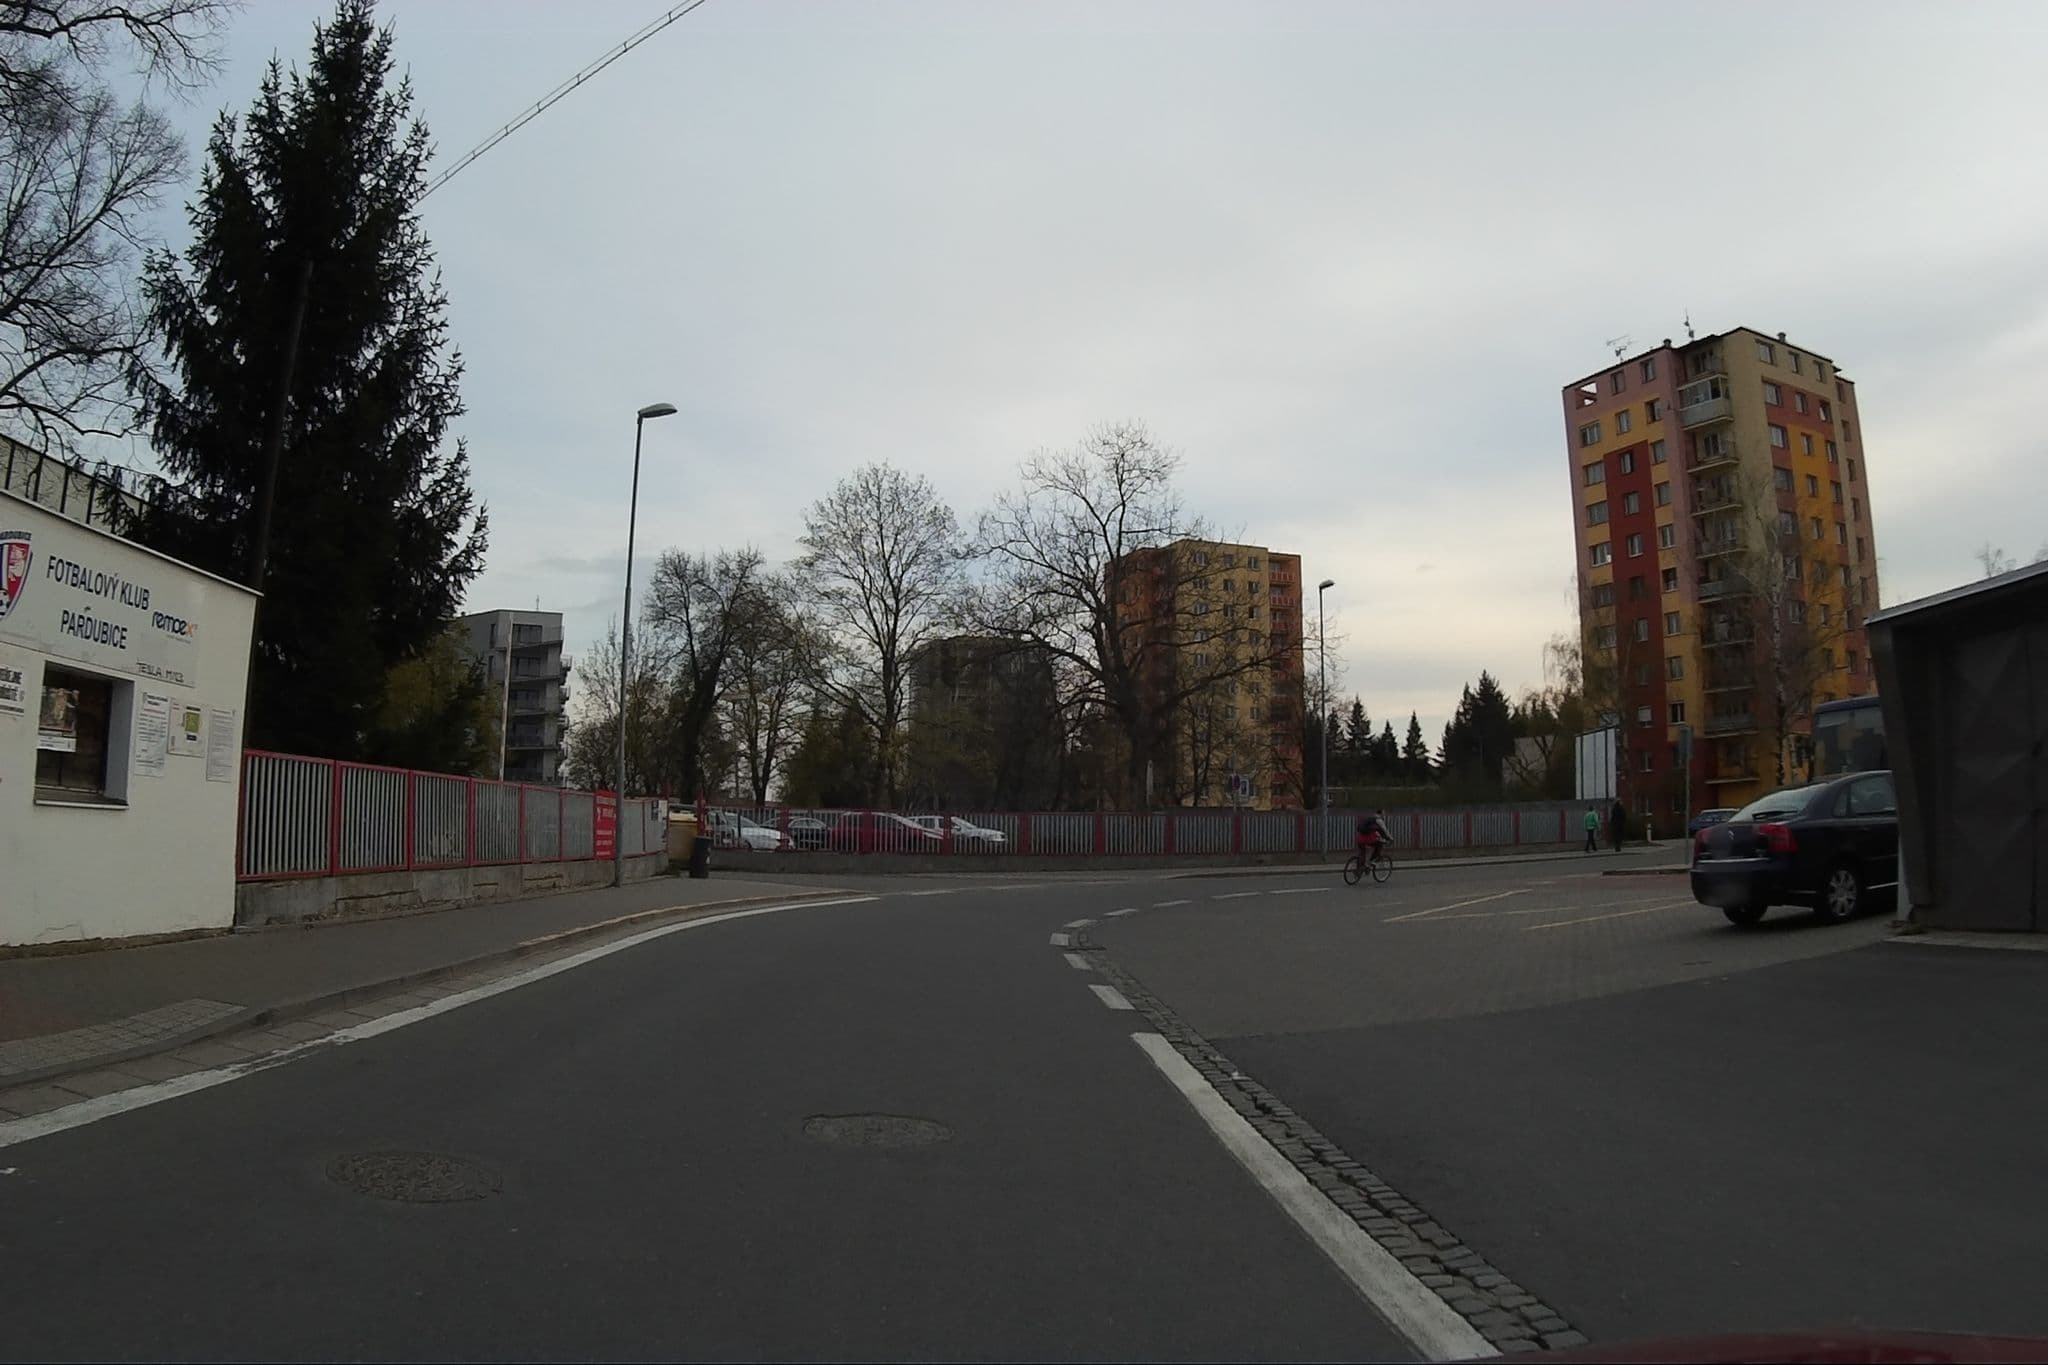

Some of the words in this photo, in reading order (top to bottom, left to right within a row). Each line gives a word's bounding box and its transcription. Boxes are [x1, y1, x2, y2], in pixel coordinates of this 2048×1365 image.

[46, 555, 119, 600] FOTBALOVÝ
[119, 580, 151, 610] KLUB
[60, 609, 128, 650] PARDUBICE
